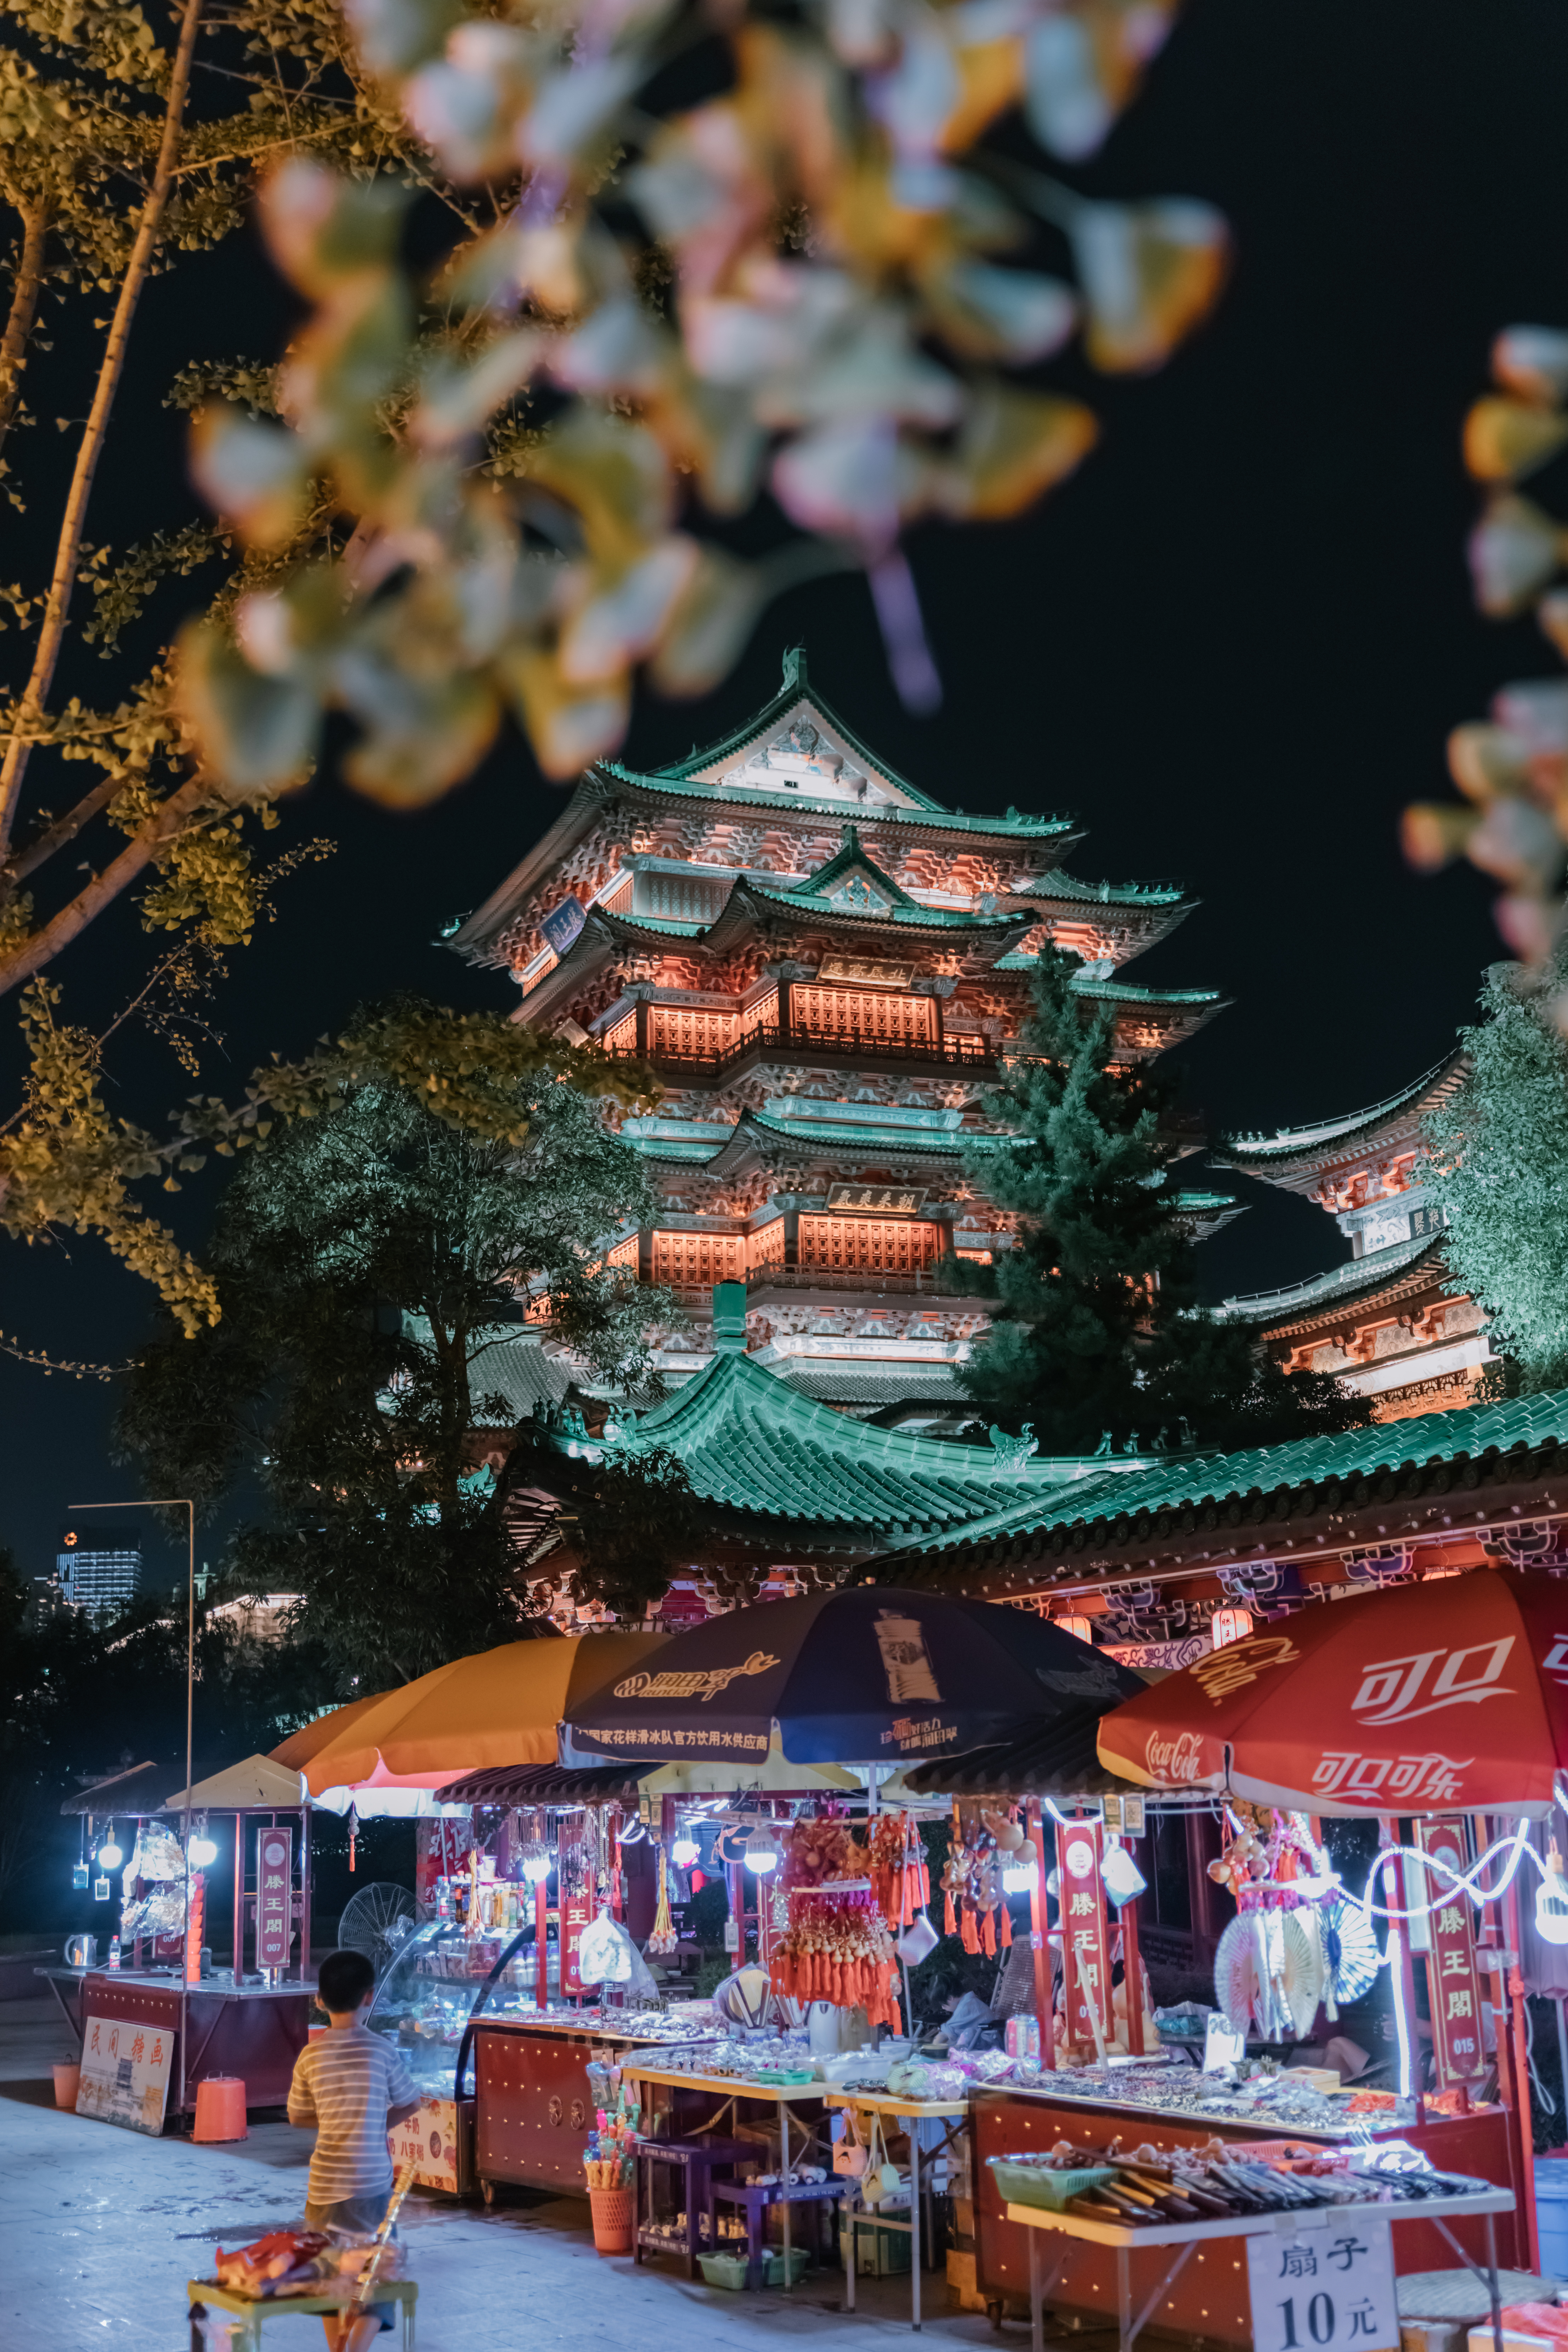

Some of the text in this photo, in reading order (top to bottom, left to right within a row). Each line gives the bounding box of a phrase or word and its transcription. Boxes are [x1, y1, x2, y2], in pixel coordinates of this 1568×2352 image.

[1222, 1617, 1234, 1644] 滕王
[1145, 1730, 1204, 1781] Coca-Cola
[1312, 1752, 1476, 1800] 可口可乐
[267, 1944, 281, 1952] 007
[91, 2024, 163, 2067] 民间糖画
[1454, 2038, 1474, 2054] 015
[401, 2141, 424, 2161] 八宝粥
[1279, 2237, 1369, 2278] 扇子
